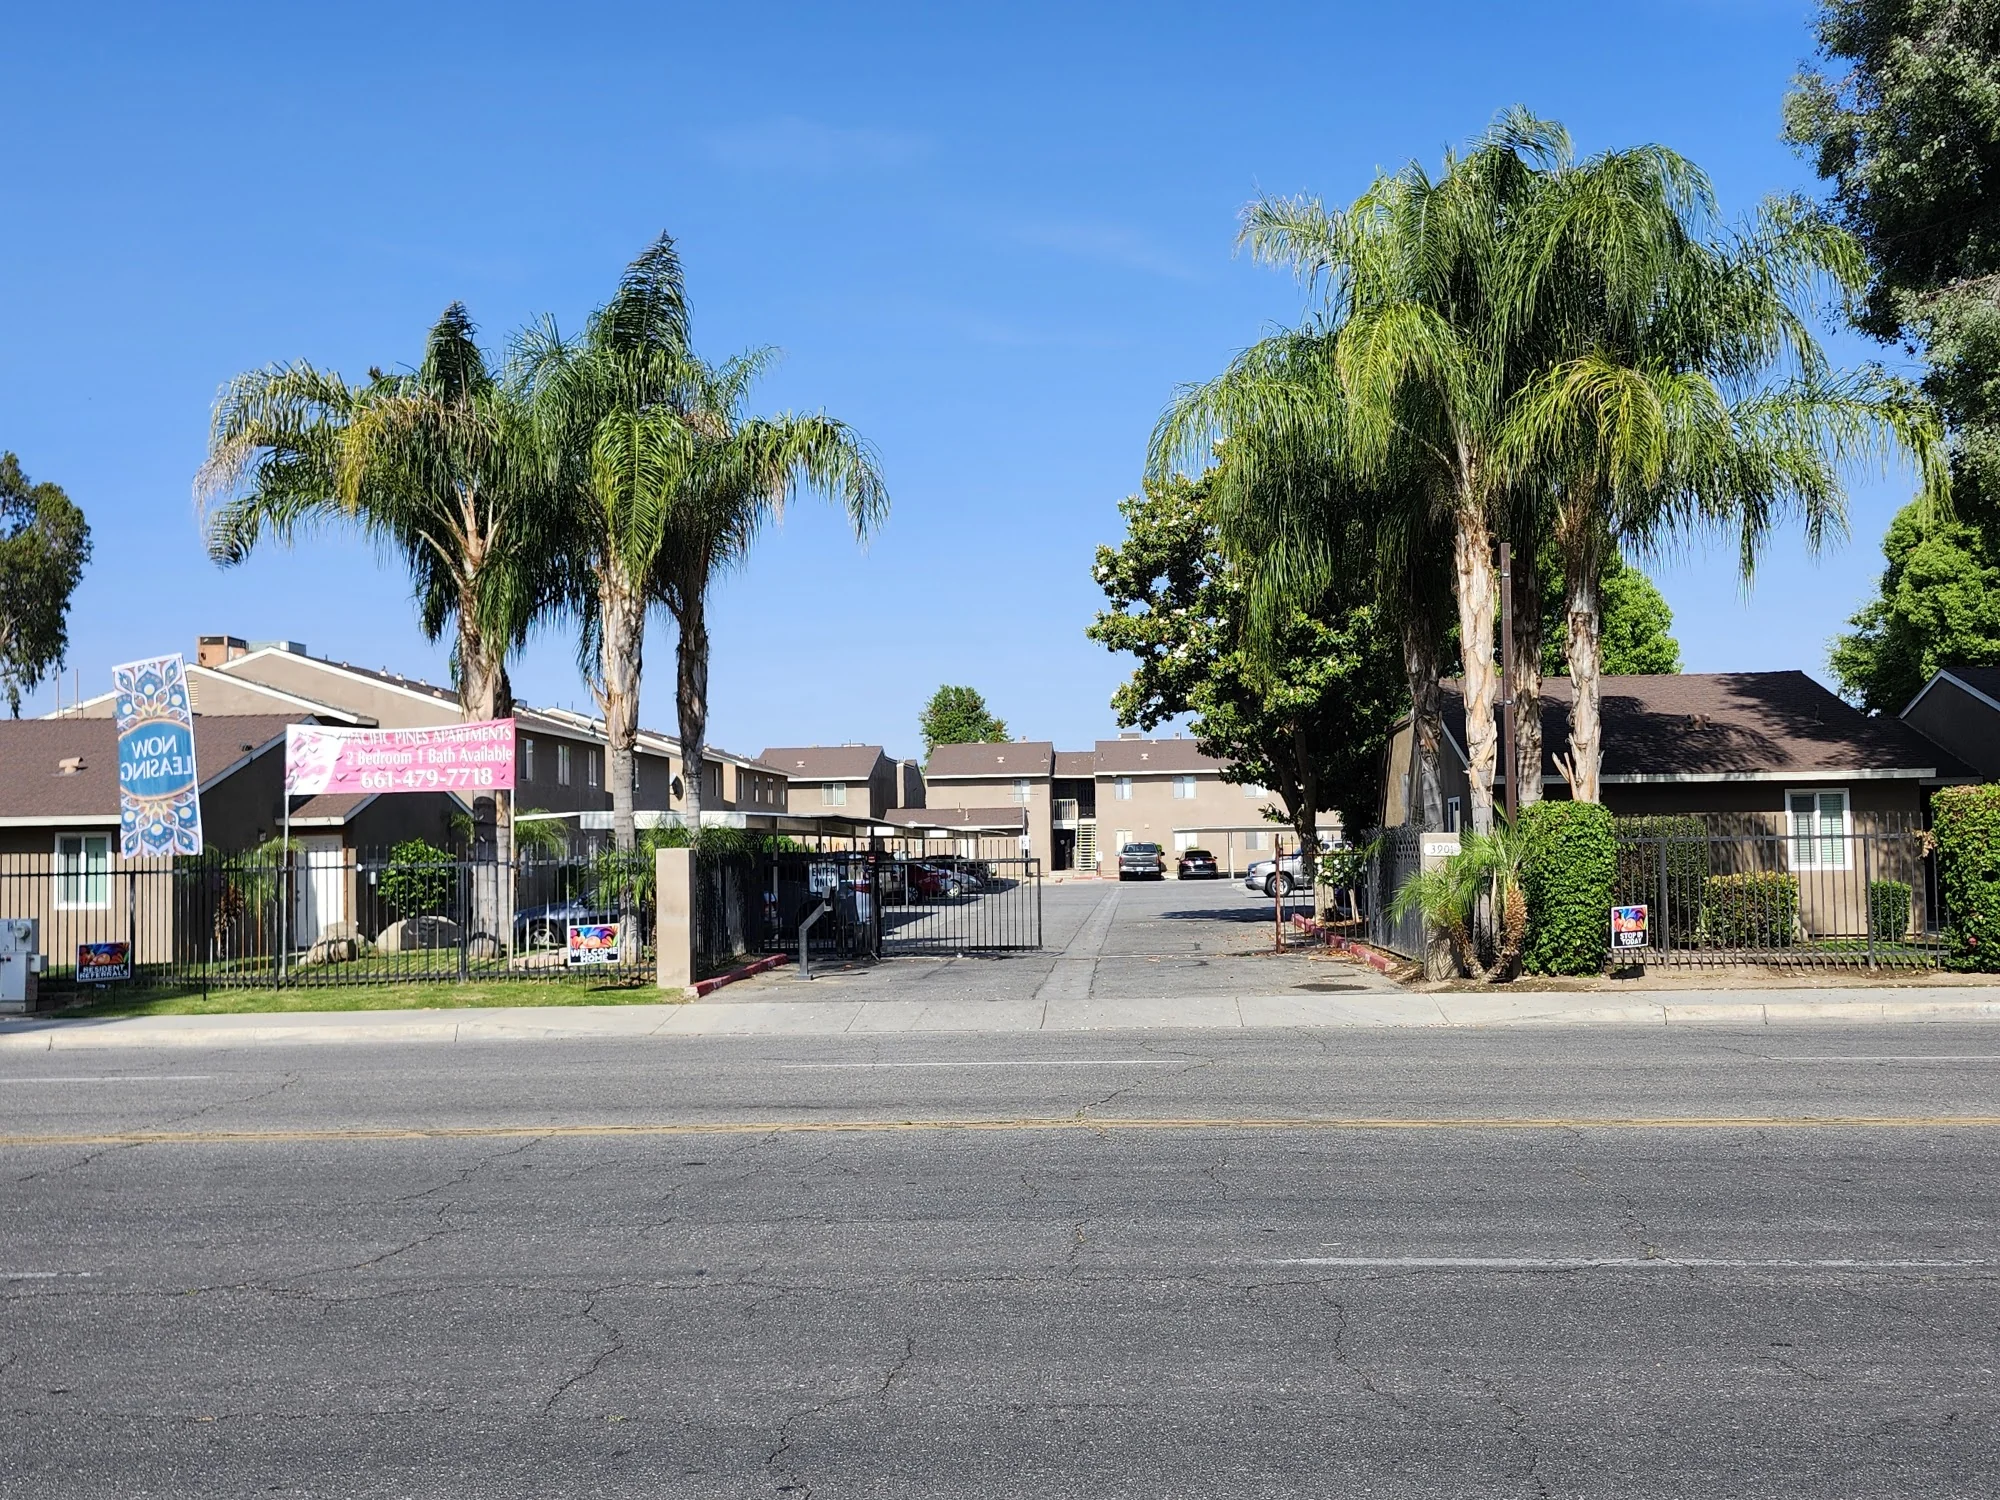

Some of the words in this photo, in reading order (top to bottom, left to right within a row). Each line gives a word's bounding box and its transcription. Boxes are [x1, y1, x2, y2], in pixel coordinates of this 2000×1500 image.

[395, 730, 429, 745] PINES
[433, 726, 512, 743] APARTMENTS
[346, 751, 354, 766] 2
[358, 749, 412, 765] Bedroom
[418, 749, 423, 764] 1
[428, 747, 456, 763] Bath
[460, 744, 513, 762] Available
[361, 767, 493, 789] 661-479-7718
[812, 867, 836, 877] ENTER
[815, 878, 834, 888] ONLY
[1620, 932, 1636, 940] STOP
[1621, 938, 1642, 946] TODAY
[571, 946, 618, 958] WELCOME
[581, 954, 609, 963] HOME
[83, 963, 126, 973] RESIDENT
